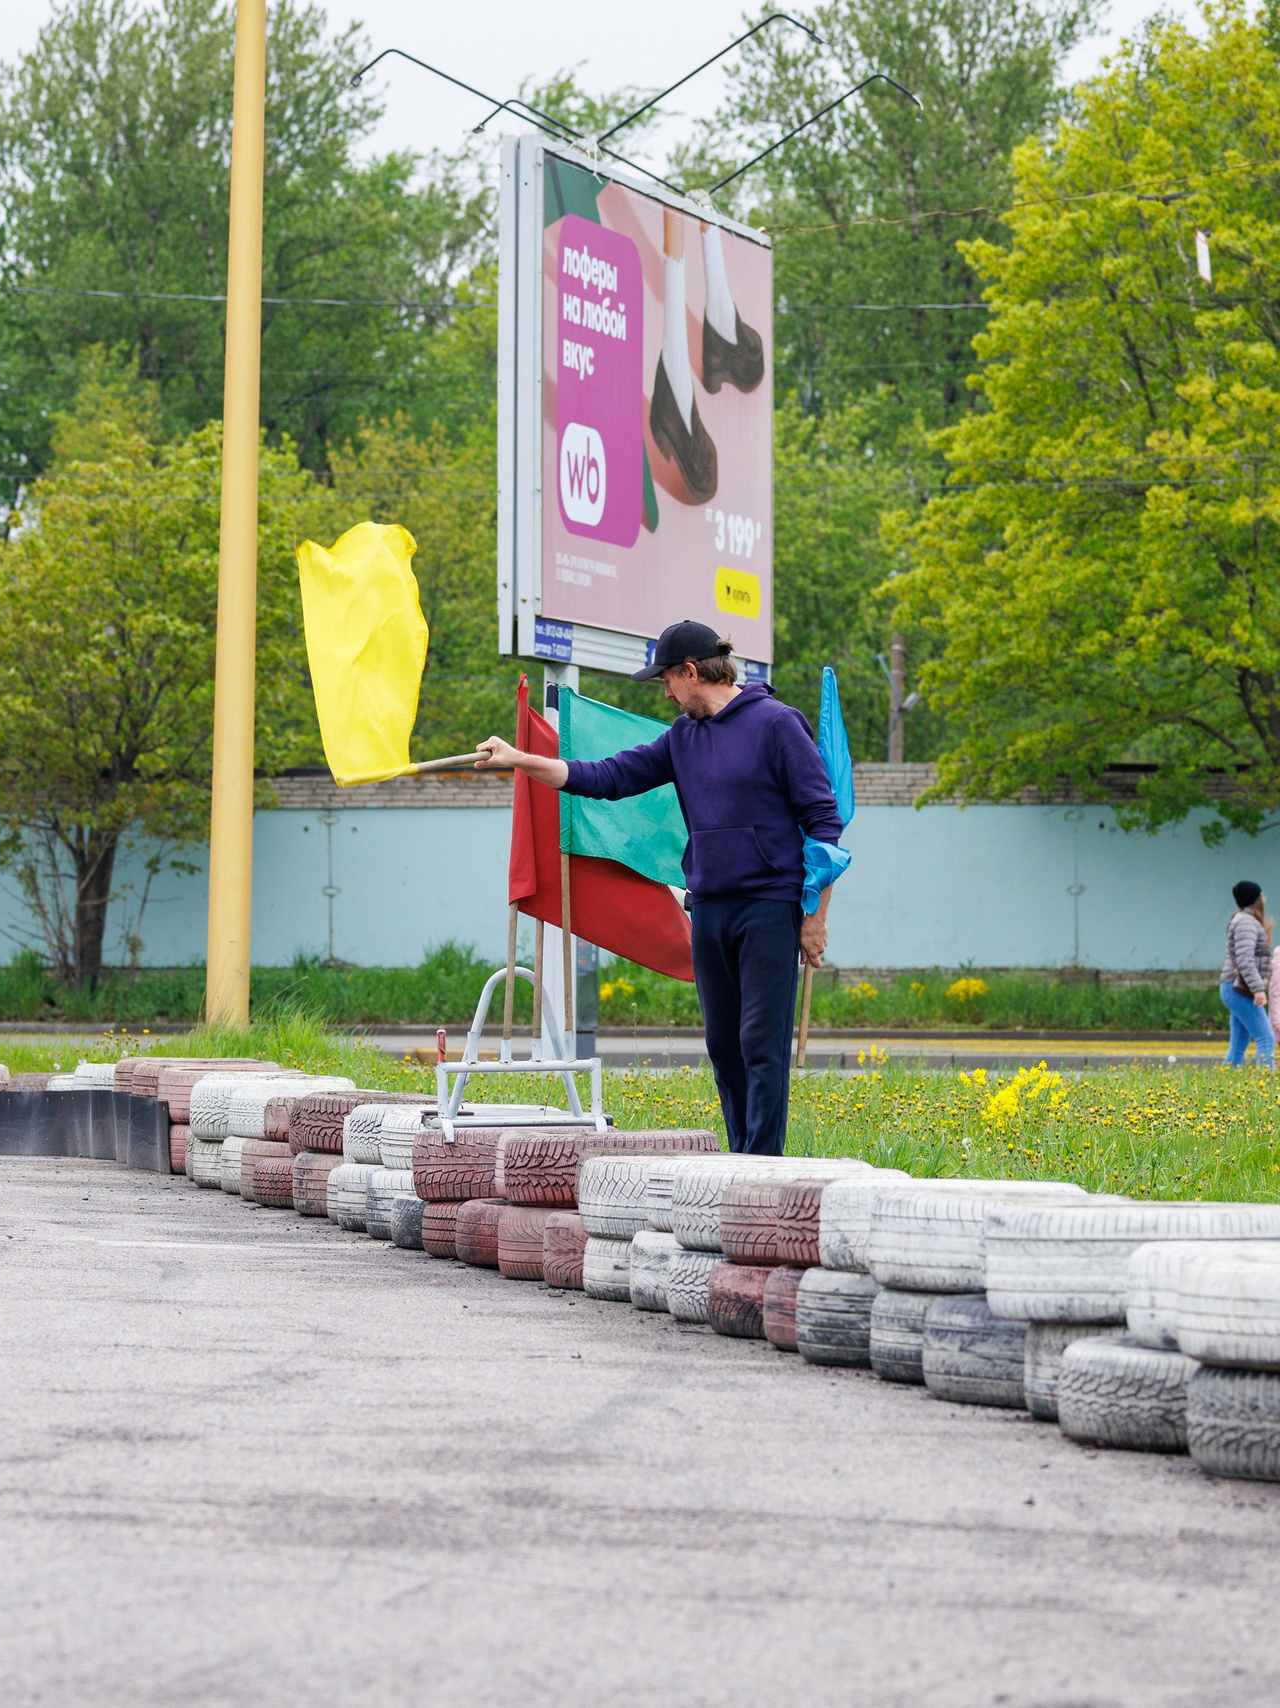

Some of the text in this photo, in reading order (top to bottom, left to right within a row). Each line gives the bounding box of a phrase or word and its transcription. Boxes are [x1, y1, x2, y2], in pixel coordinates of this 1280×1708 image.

[563, 245, 617, 295] лоферы
[563, 293, 626, 341] на любой
[563, 339, 594, 381] вкус
[567, 437, 600, 504] wb
